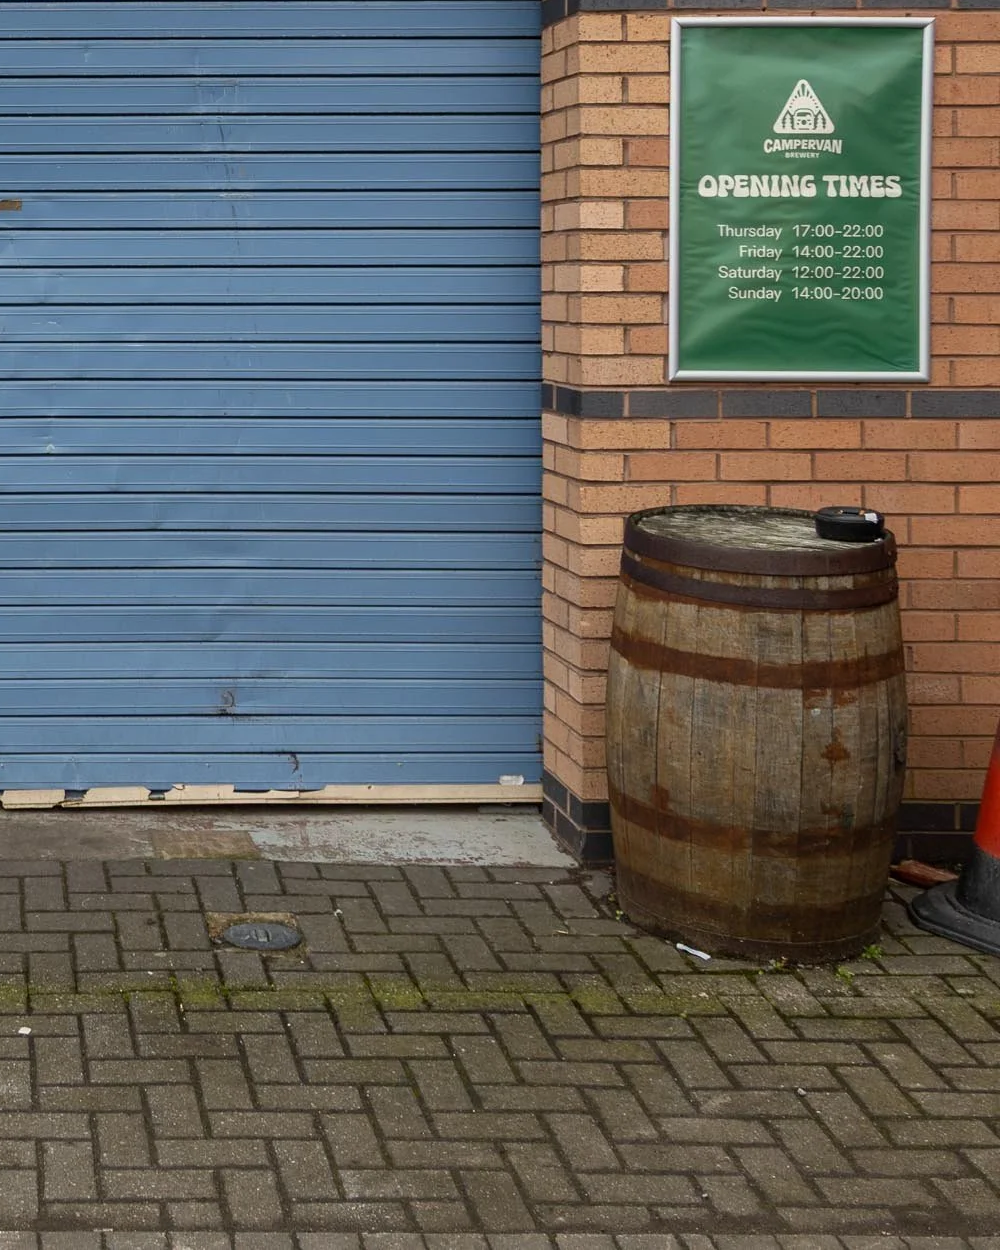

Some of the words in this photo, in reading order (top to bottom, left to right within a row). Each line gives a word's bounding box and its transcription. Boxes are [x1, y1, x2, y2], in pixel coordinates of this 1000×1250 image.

[763, 138, 843, 155] CAMPERVAN
[784, 151, 820, 159] BREWERY
[697, 174, 818, 198] OPENING
[822, 174, 903, 198] TIMES
[716, 224, 783, 241] Thursday
[738, 245, 783, 261] Friday
[717, 265, 783, 282] Saturday
[728, 286, 782, 303] Sunday
